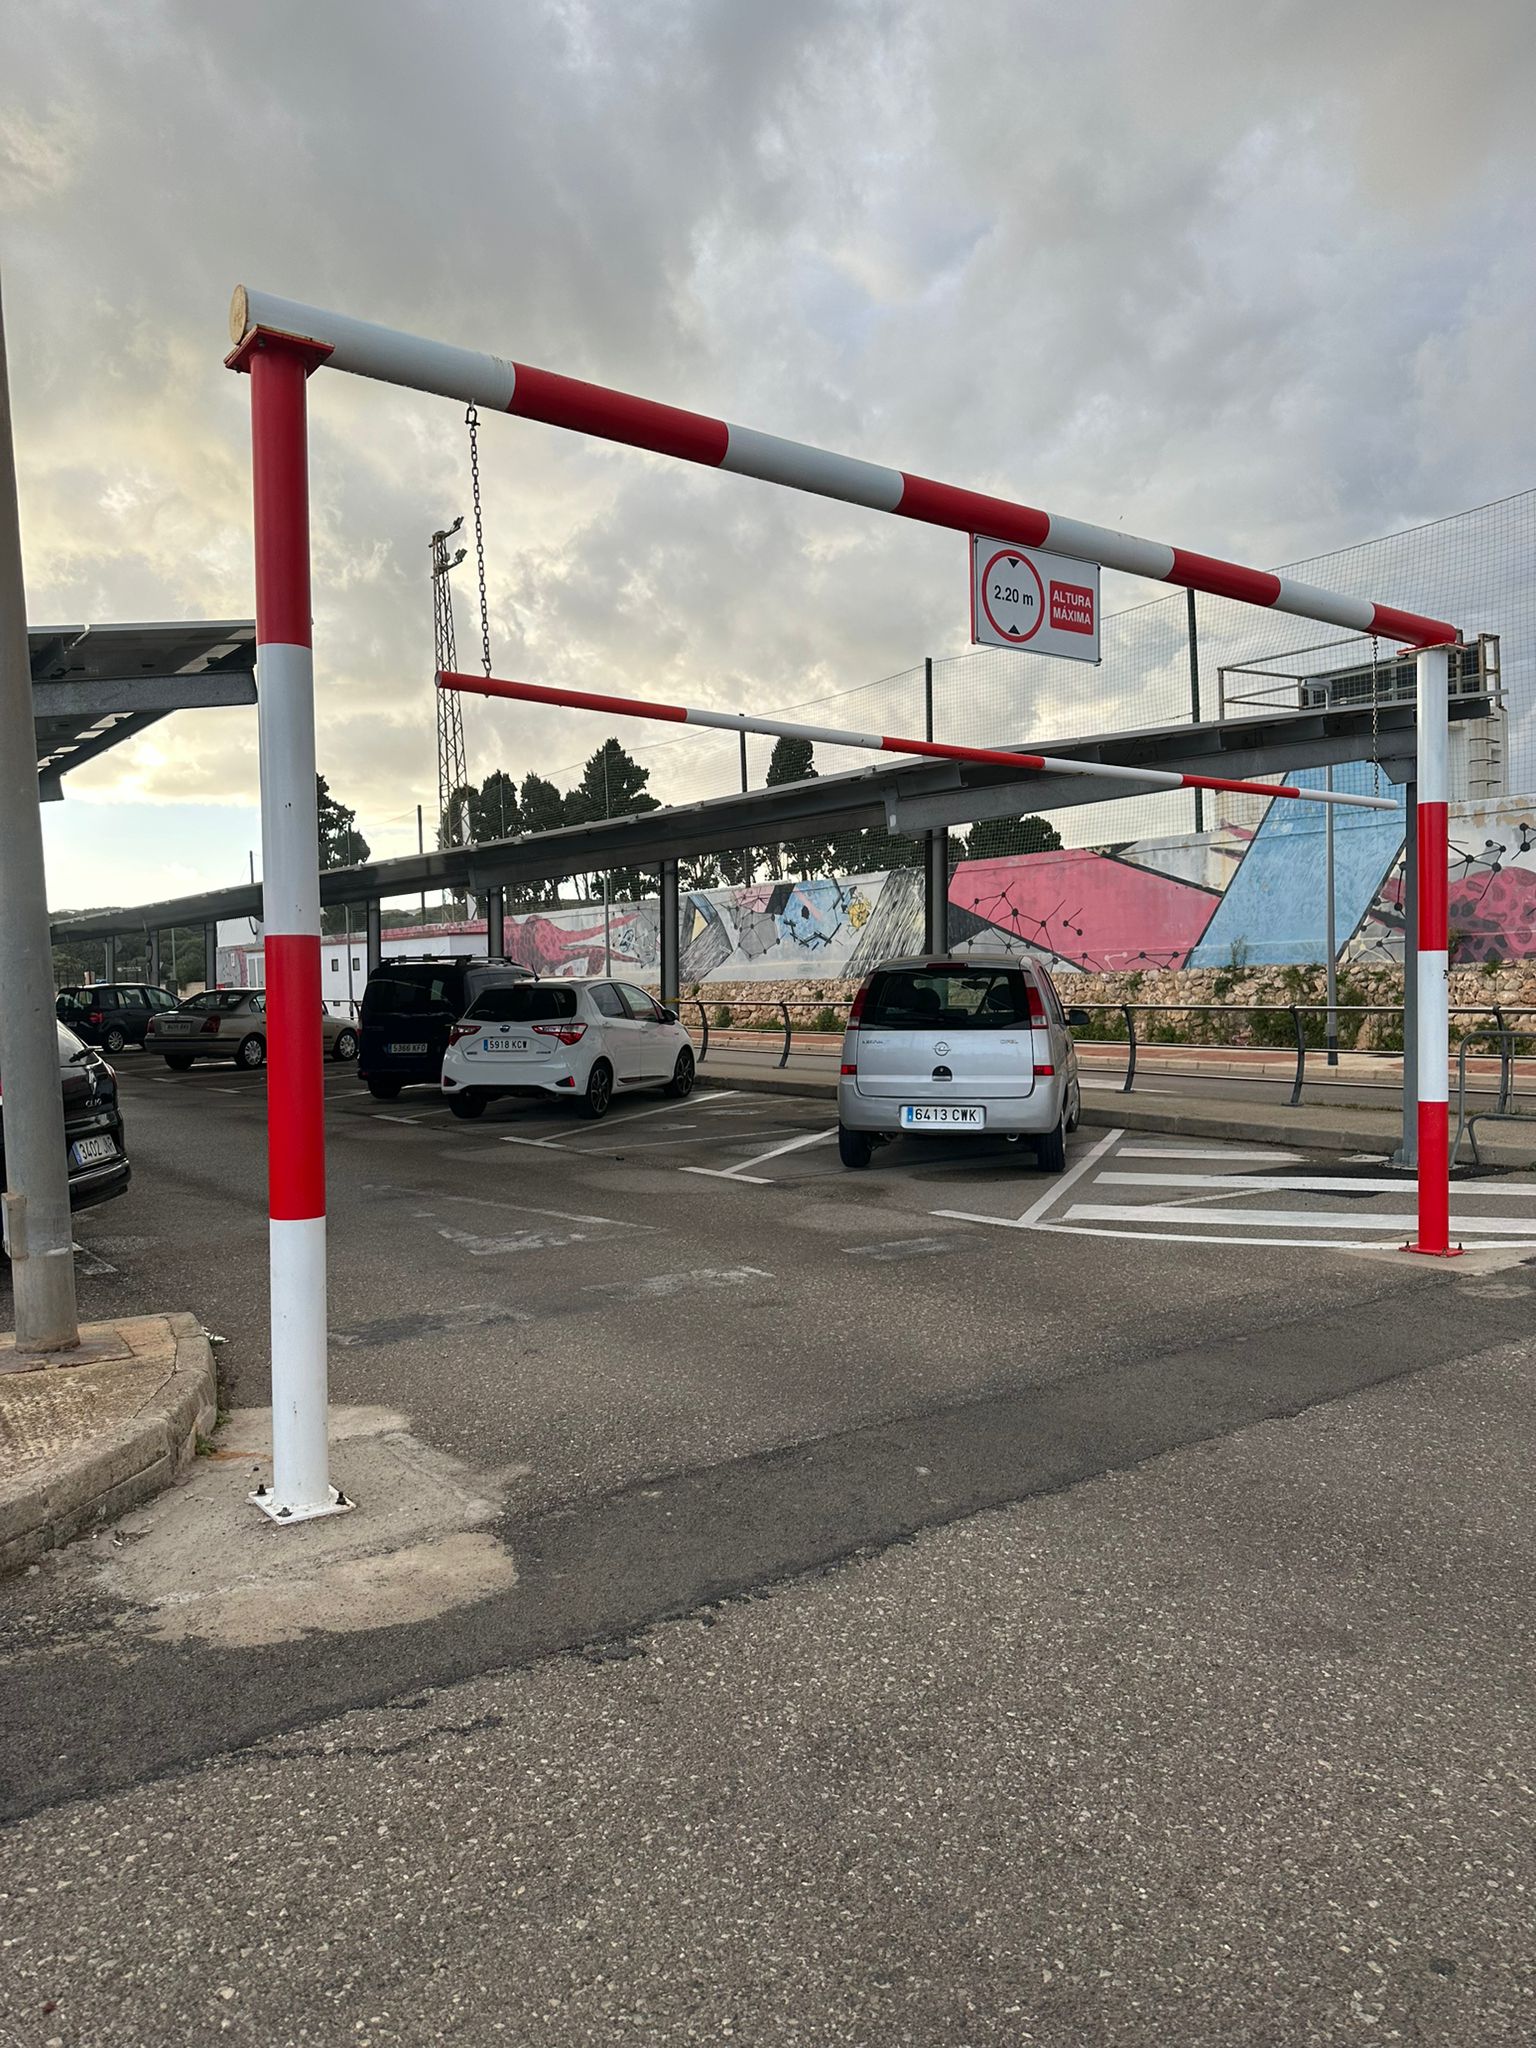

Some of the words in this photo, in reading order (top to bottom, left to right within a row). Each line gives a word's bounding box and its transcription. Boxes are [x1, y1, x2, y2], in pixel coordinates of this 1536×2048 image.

[994, 584, 1019, 603] 2.20
[1022, 592, 1034, 606] m
[1052, 590, 1092, 609] ALTURA
[1052, 606, 1092, 625] MÁXIMA
[489, 1040, 510, 1049] 5918
[914, 1107, 947, 1121] 6413
[951, 1108, 977, 1122] CWK
[79, 1139, 102, 1160] 3402
